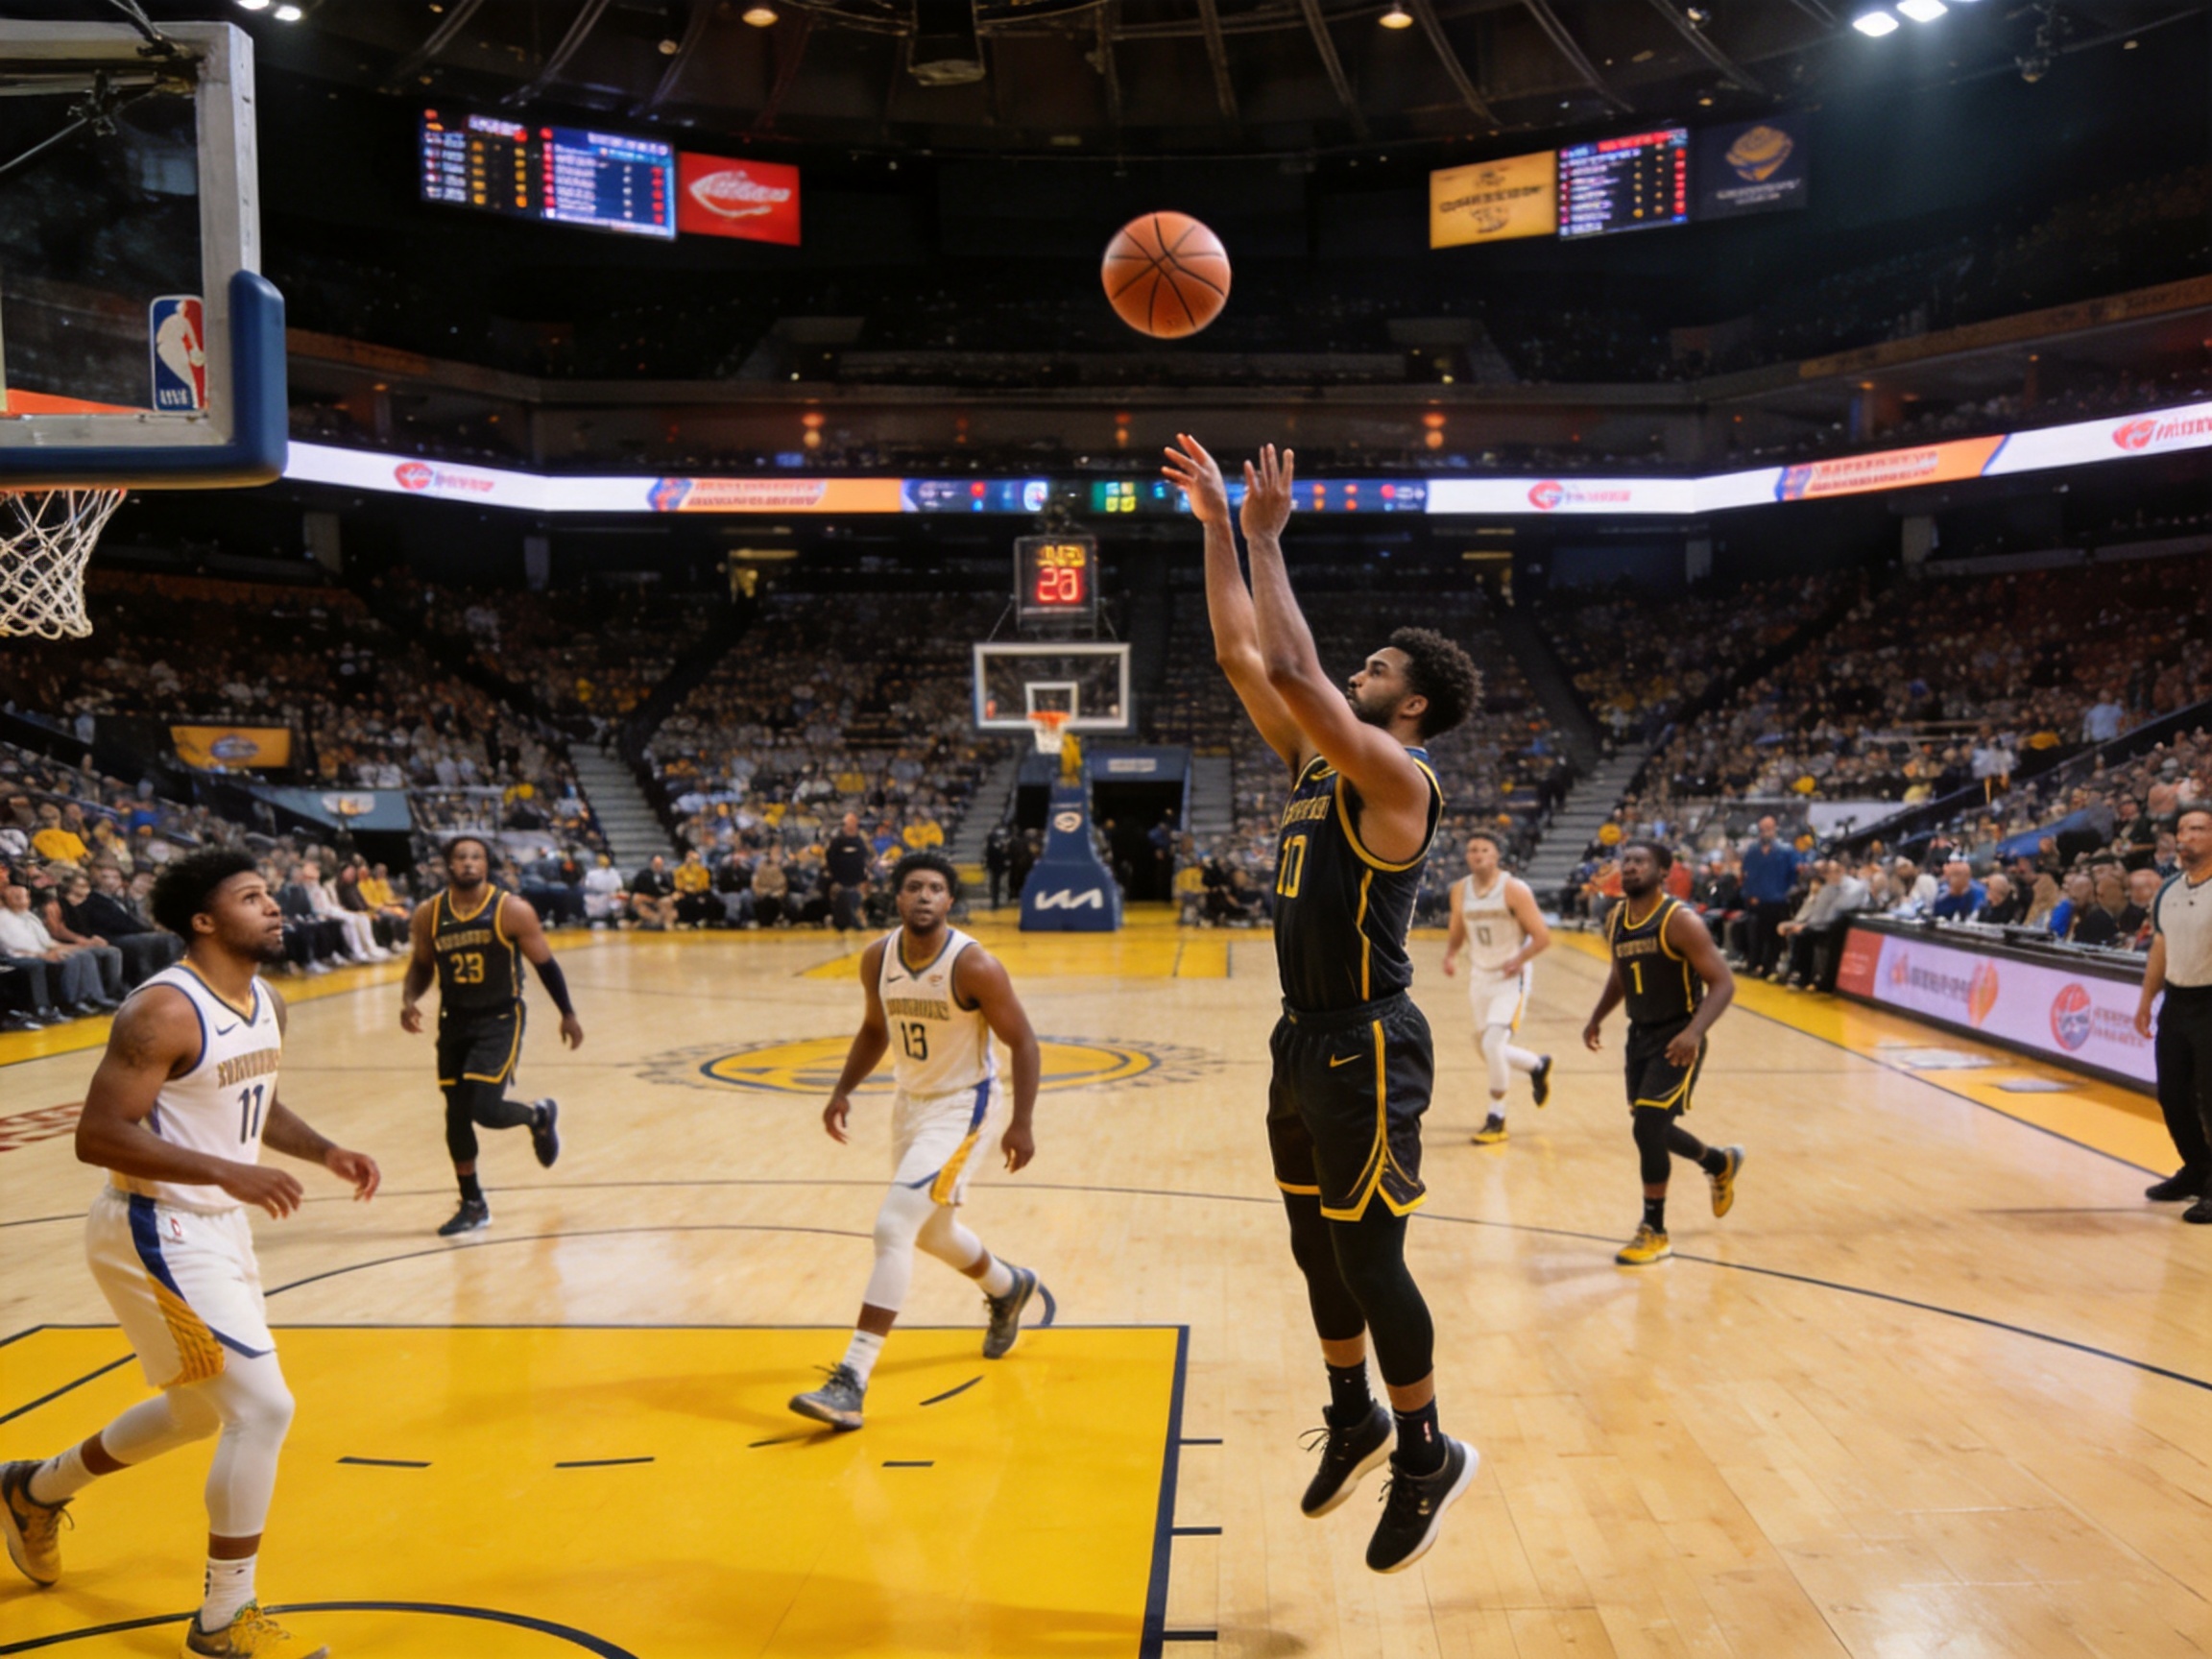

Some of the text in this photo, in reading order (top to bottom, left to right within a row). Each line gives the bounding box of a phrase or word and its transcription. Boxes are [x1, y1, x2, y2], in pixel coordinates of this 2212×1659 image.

[1277, 834, 1308, 899] 10
[450, 952, 485, 983] 23
[1630, 961, 1643, 995] 1
[901, 1022, 928, 1061] 13
[238, 1084, 264, 1144] 11
